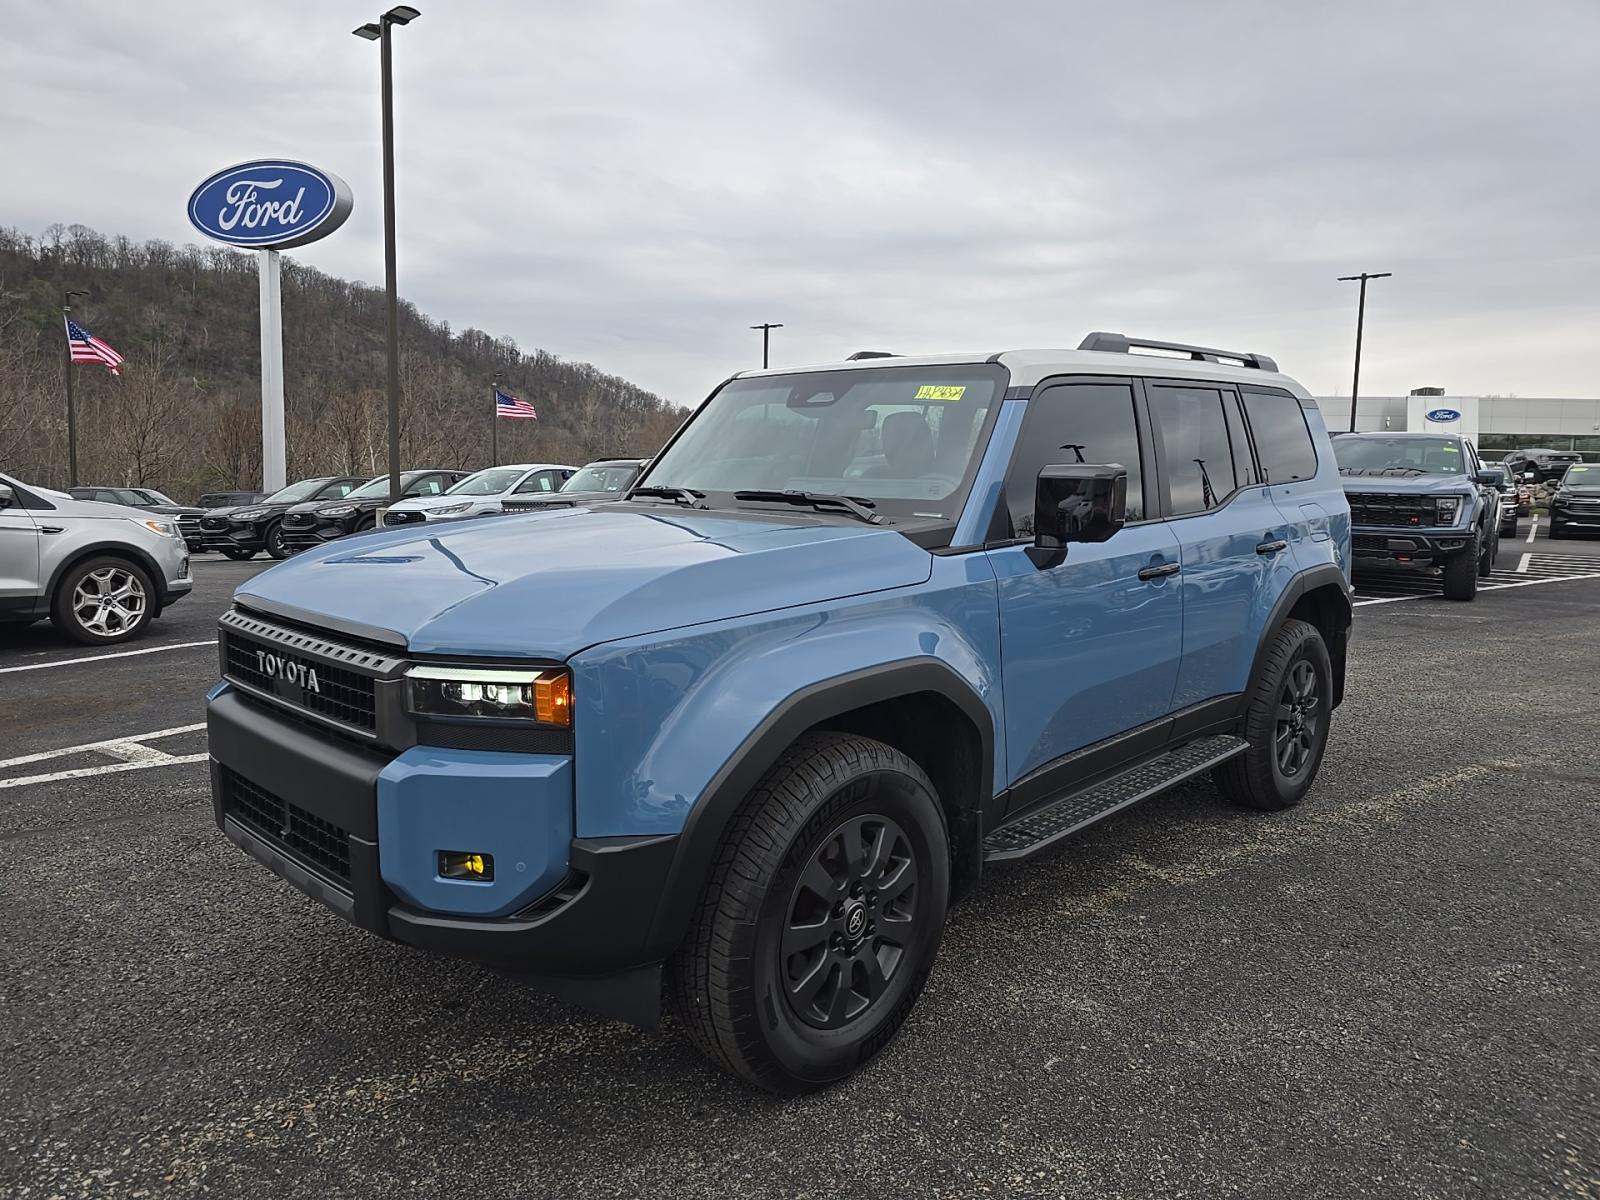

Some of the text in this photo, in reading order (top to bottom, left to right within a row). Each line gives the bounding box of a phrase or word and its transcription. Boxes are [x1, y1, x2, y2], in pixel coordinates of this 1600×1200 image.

[218, 179, 306, 231] Ford
[1434, 411, 1454, 419] Ford
[256, 650, 320, 693] TOYOTA
[789, 777, 872, 863] MICHELIN
